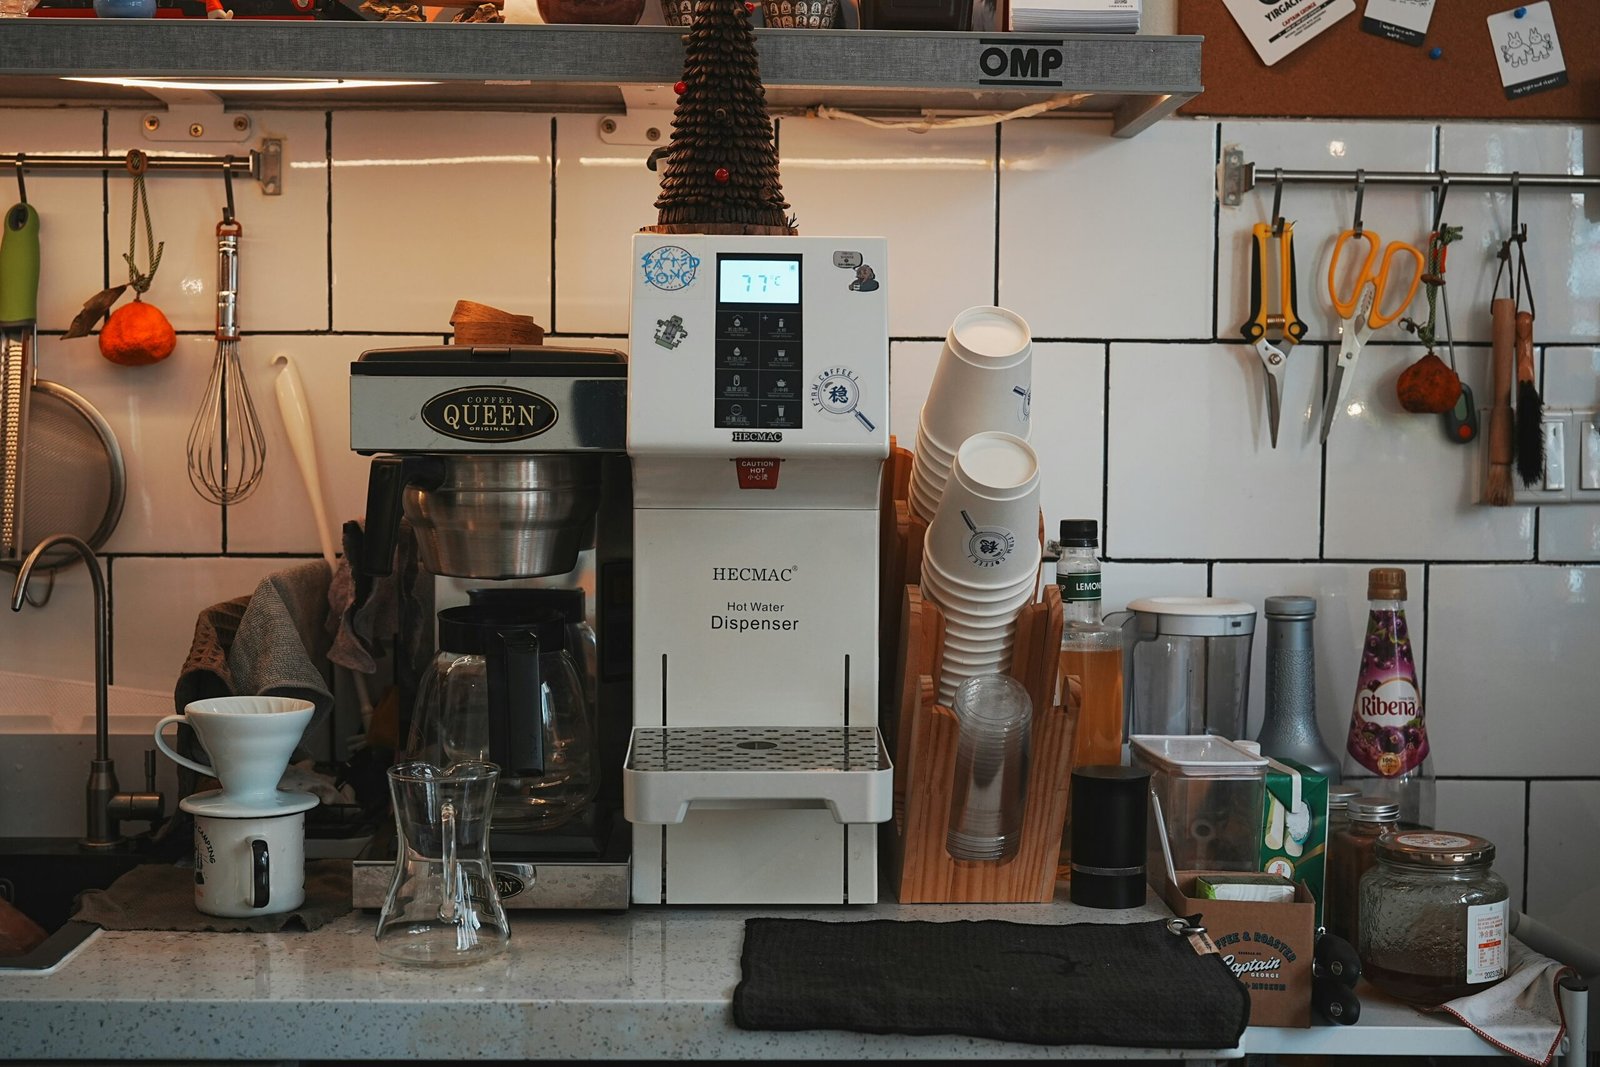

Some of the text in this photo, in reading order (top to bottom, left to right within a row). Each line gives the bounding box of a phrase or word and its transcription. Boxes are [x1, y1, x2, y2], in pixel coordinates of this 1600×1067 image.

[979, 47, 1063, 78] OMP
[818, 368, 853, 381] COFFEE
[467, 396, 513, 404] COFFEE
[828, 385, 849, 404] 稳
[443, 404, 536, 430] QUEEN
[733, 432, 783, 441] HECMAC
[727, 602, 785, 612] Hot Water
[711, 615, 799, 633] Dispenser
[1361, 694, 1416, 716] Ribena
[197, 826, 216, 864] CAMPING
[1215, 932, 1240, 949] FFEE
[1223, 954, 1281, 978] Captain
